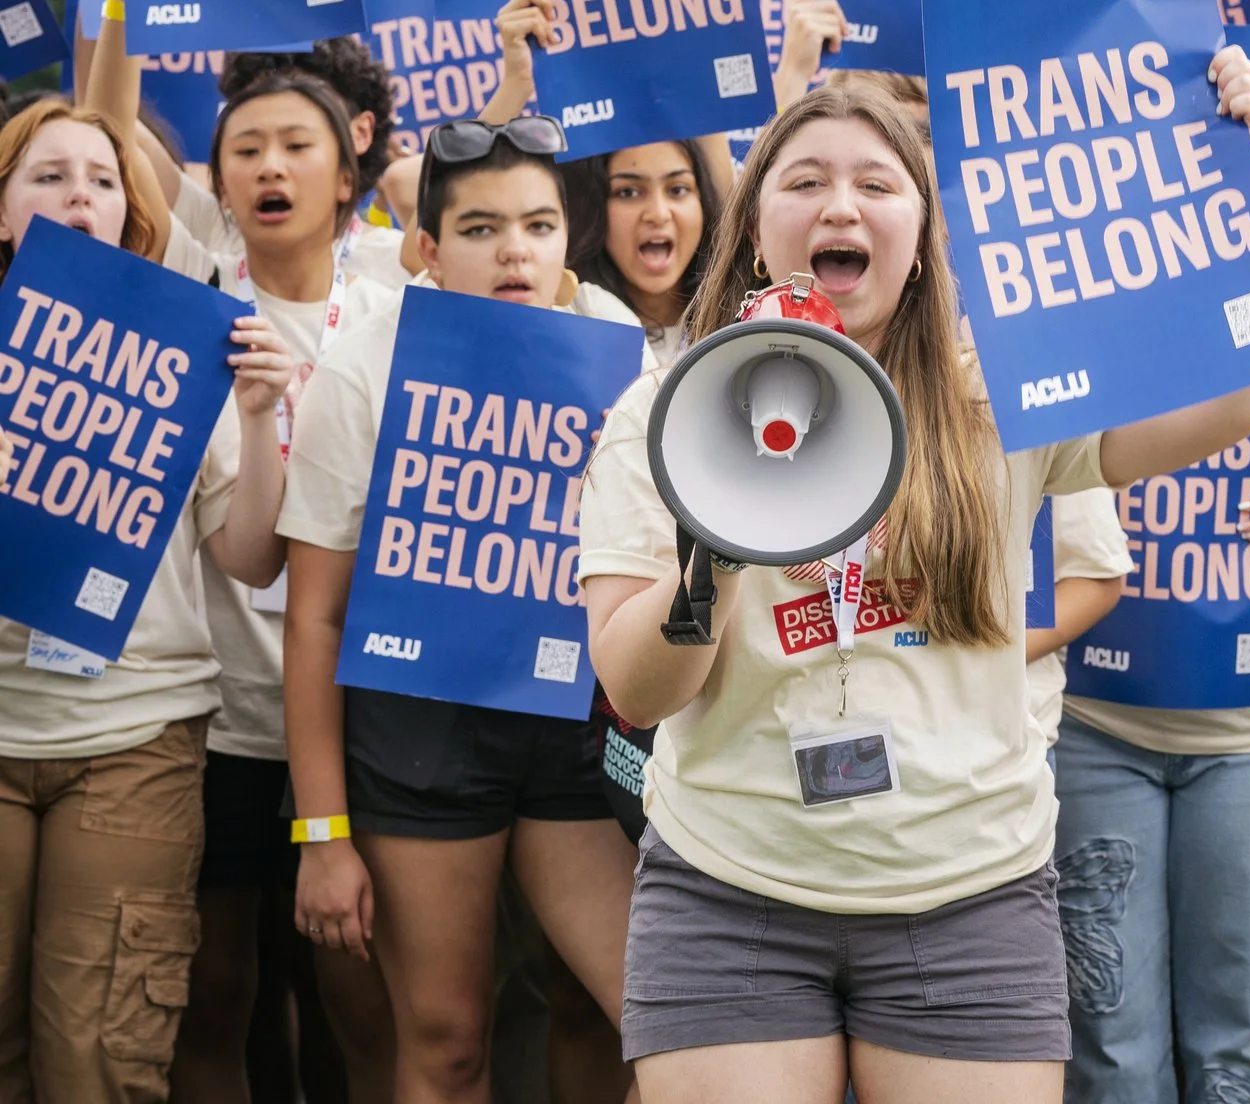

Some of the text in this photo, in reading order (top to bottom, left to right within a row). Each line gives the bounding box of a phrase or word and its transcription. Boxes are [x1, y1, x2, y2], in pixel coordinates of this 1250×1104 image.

[146, 3, 201, 26] ACLU
[843, 21, 879, 45] CLU
[562, 98, 615, 128] ACLU
[946, 41, 1176, 149] TRANS
[960, 120, 1224, 235] PEOPLE
[8, 286, 190, 409] TRANS
[1021, 369, 1091, 411] ACLU
[403, 379, 588, 468] TRANS
[387, 447, 580, 537] PEOPLE
[374, 515, 587, 608] BELONG
[843, 561, 862, 604] ACLU
[363, 632, 422, 661] ACLU
[894, 631, 929, 647] ACLU
[1083, 646, 1130, 672] ACLU
